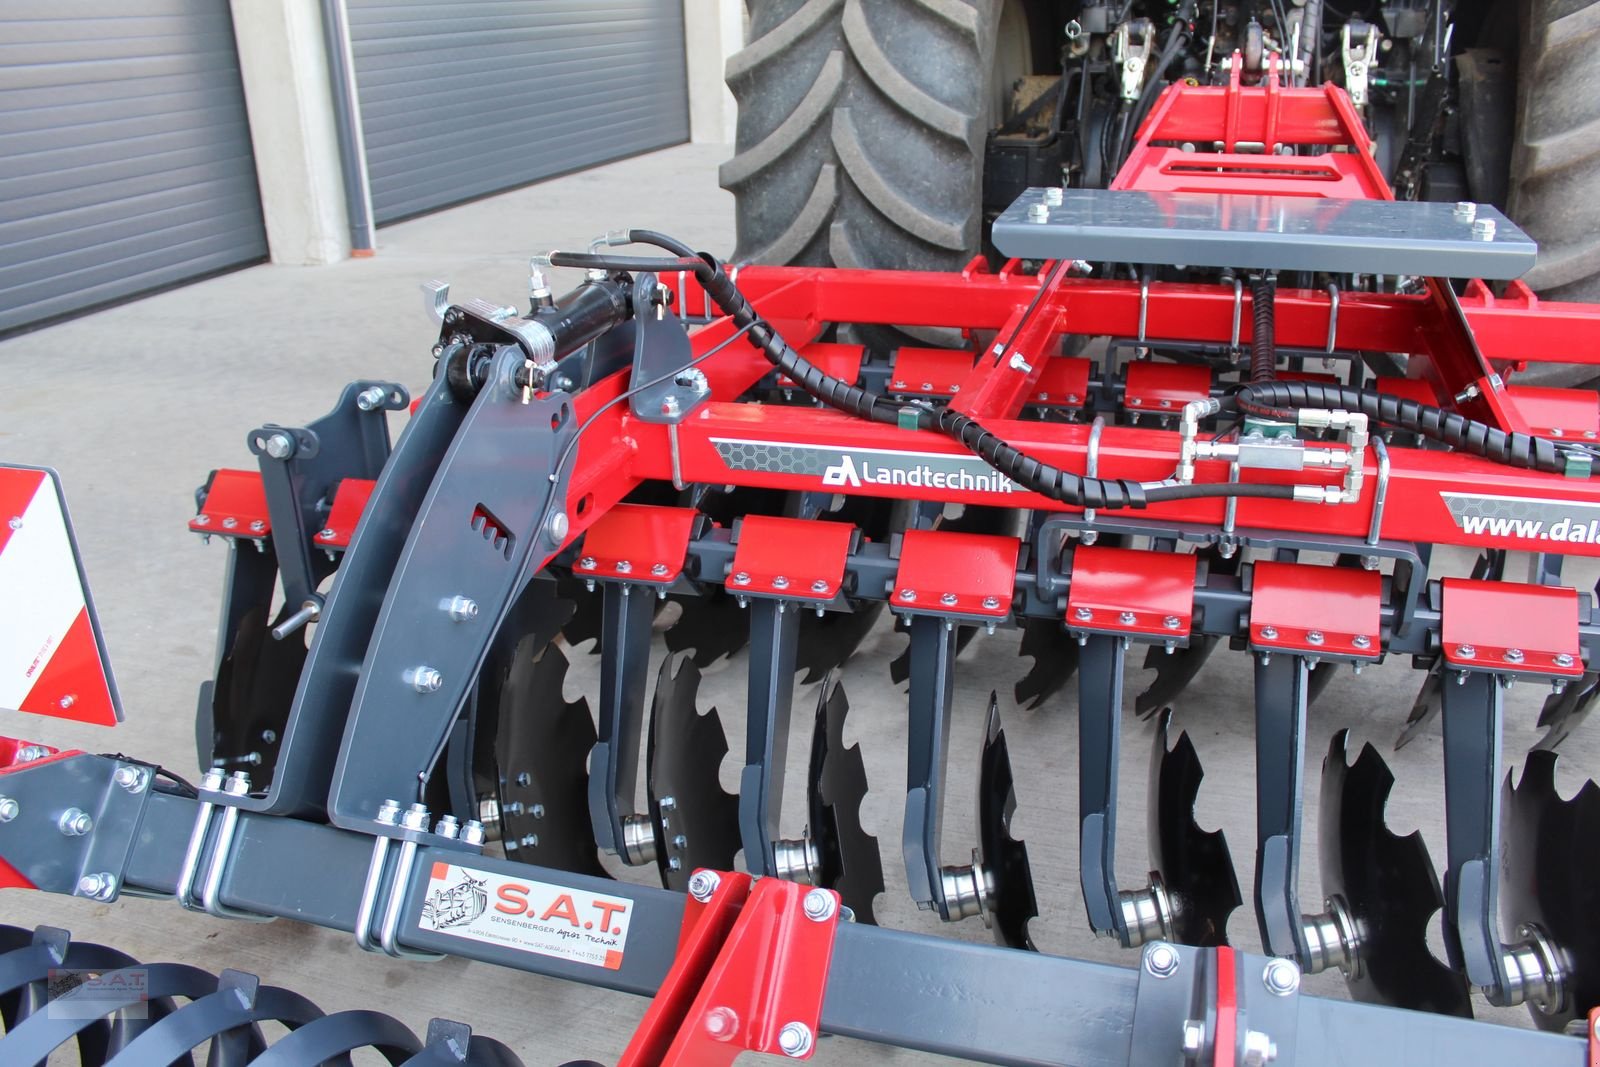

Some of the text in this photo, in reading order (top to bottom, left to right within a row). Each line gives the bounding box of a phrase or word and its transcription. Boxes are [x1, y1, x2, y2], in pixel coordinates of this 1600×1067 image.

[862, 462, 1012, 493] Landtechnik
[1462, 515, 1600, 544] www.dal
[494, 883, 625, 935] S.A.T.
[490, 915, 618, 946] SENSENBERGER Agrar Technik
